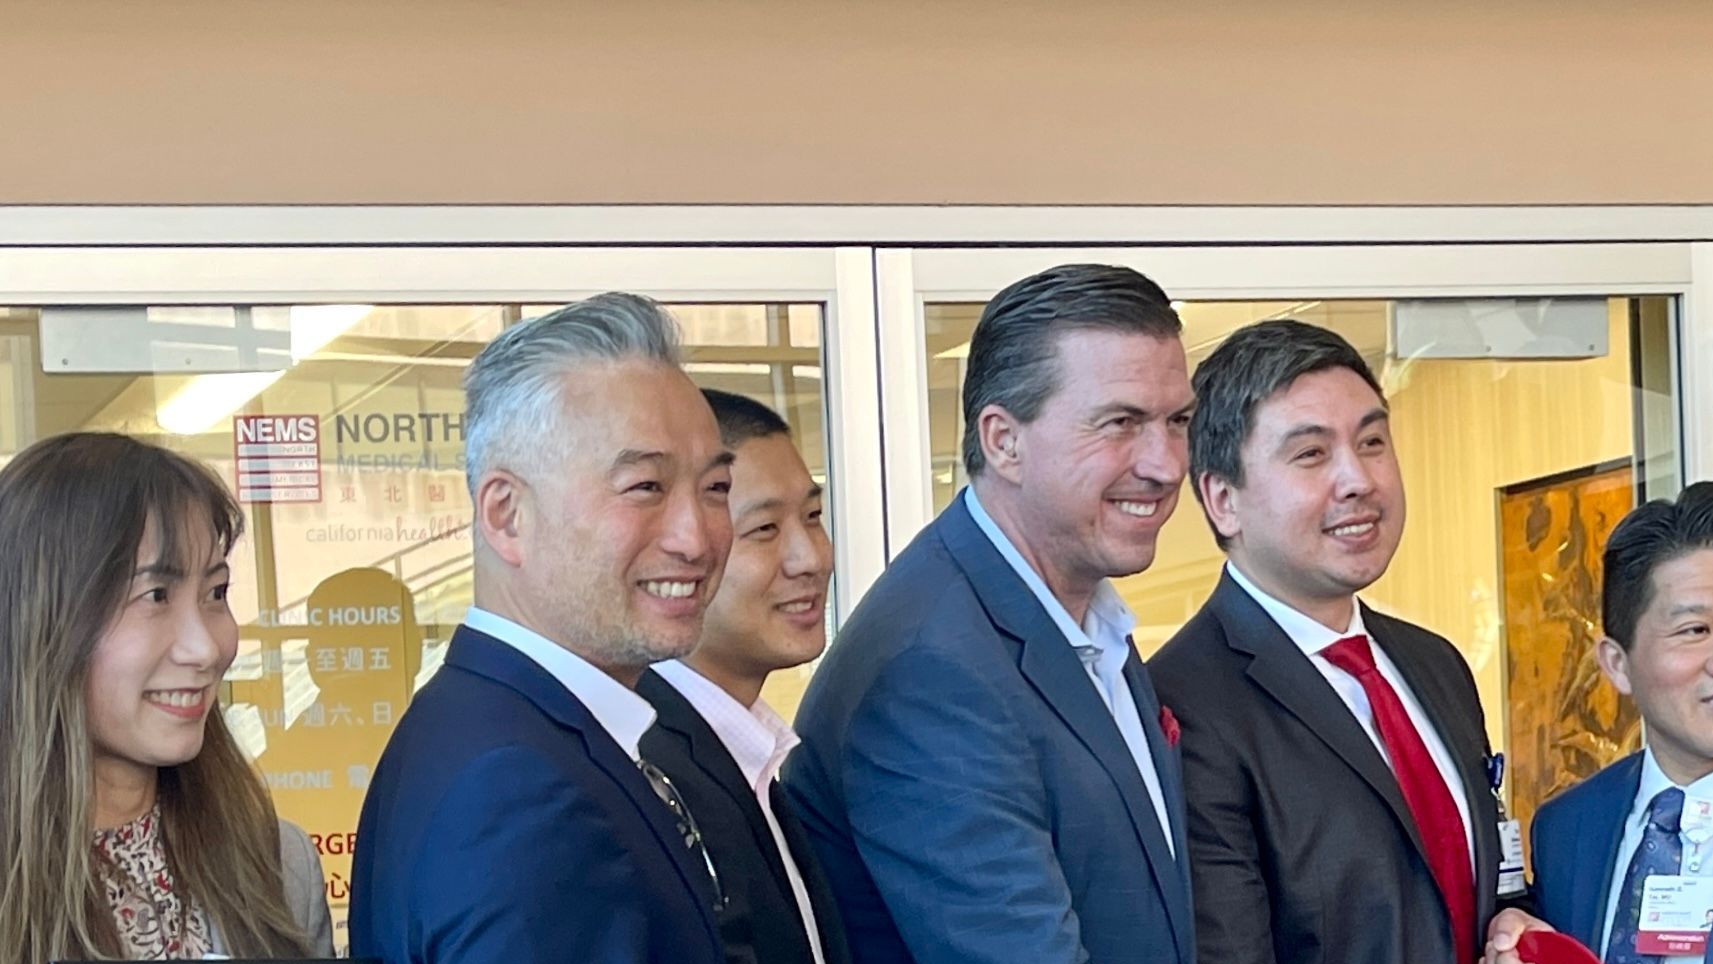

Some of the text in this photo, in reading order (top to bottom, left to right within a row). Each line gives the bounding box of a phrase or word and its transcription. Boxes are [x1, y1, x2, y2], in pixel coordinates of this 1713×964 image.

[237, 418, 317, 443] NEMS
[336, 413, 466, 443] NORTH
[337, 454, 442, 475] MEDICAL
[328, 606, 401, 626] HOURS
